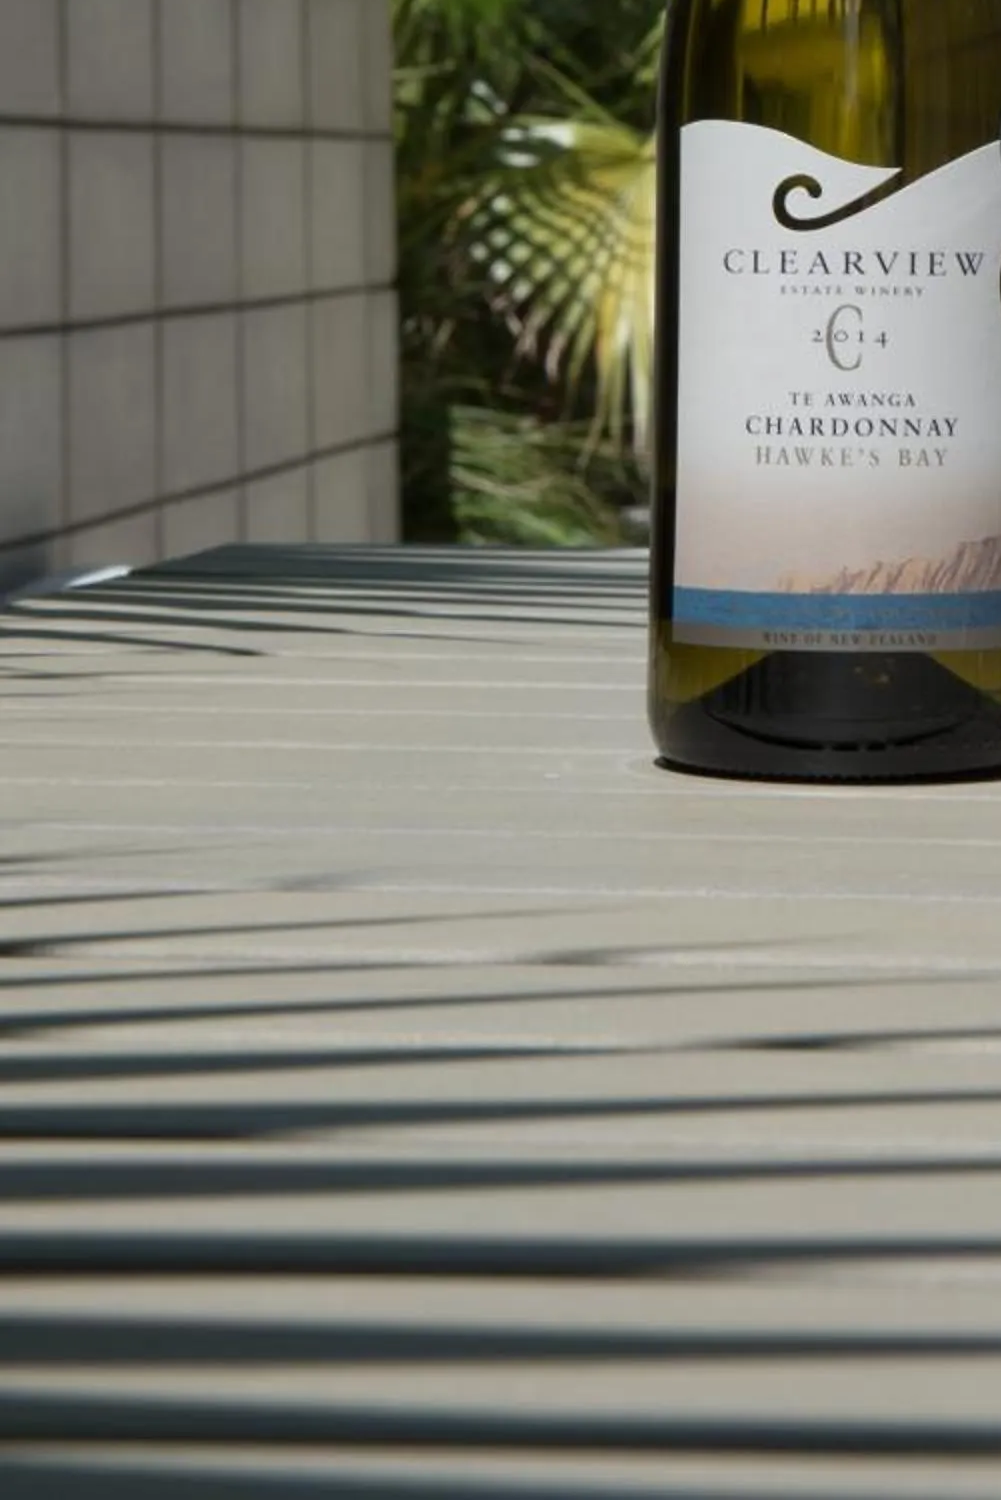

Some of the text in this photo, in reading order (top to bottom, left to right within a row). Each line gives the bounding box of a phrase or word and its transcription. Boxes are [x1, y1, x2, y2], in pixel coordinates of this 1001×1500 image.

[722, 248, 986, 278] CLEARVIEW
[780, 284, 926, 299] ESTATE WINERY
[811, 329, 889, 349] 2014
[787, 391, 917, 408] TE AWANGA
[745, 414, 960, 438] CHARDONNAY
[755, 444, 950, 468] HAWKE'S BAY
[803, 631, 822, 645] OF
[830, 631, 862, 645] NEW
[868, 631, 938, 646] ZEALAND
